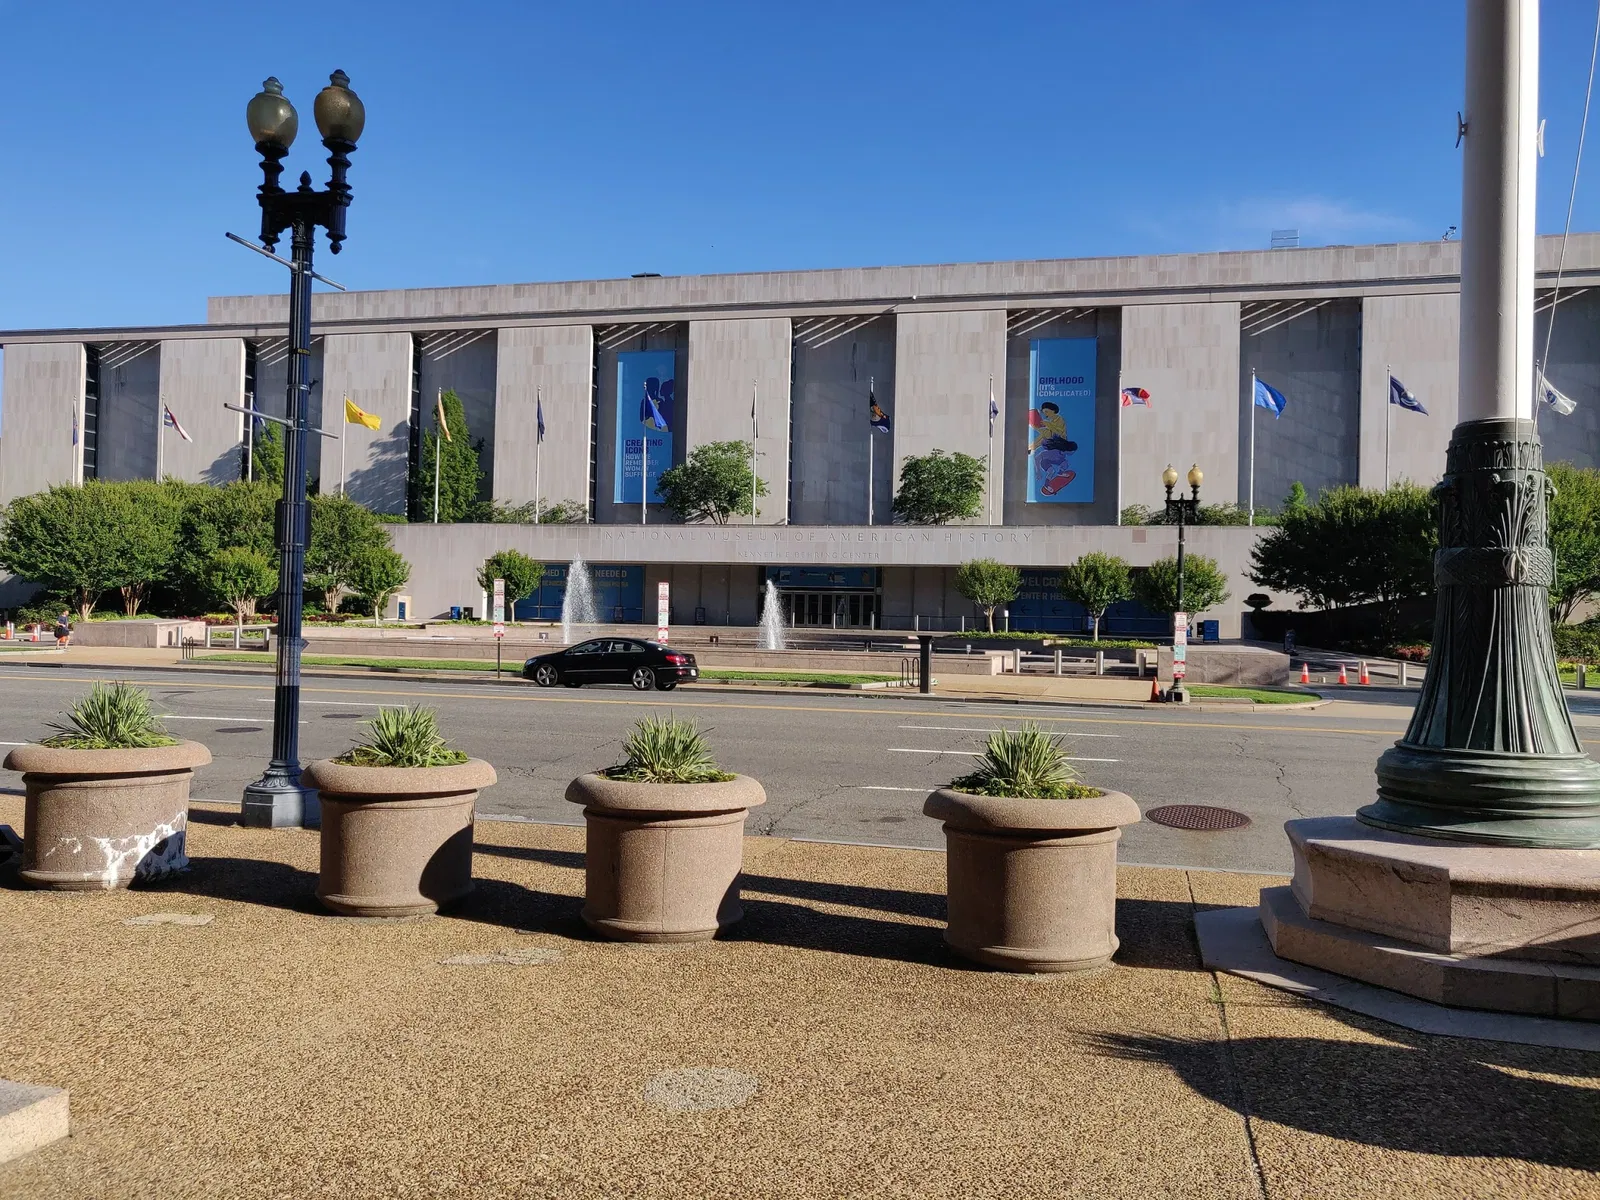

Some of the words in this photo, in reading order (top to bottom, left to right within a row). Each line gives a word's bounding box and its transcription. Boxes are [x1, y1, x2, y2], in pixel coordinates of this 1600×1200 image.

[604, 531, 696, 541] NATIONAL
[707, 531, 783, 541] MUSEUM
[794, 532, 815, 541] OF
[827, 532, 932, 542] AMERICAN
[944, 532, 1032, 543] HISTORY
[841, 551, 880, 559] CENTER
[594, 570, 627, 578] NEEDED
[1021, 592, 1048, 600] ENTER
